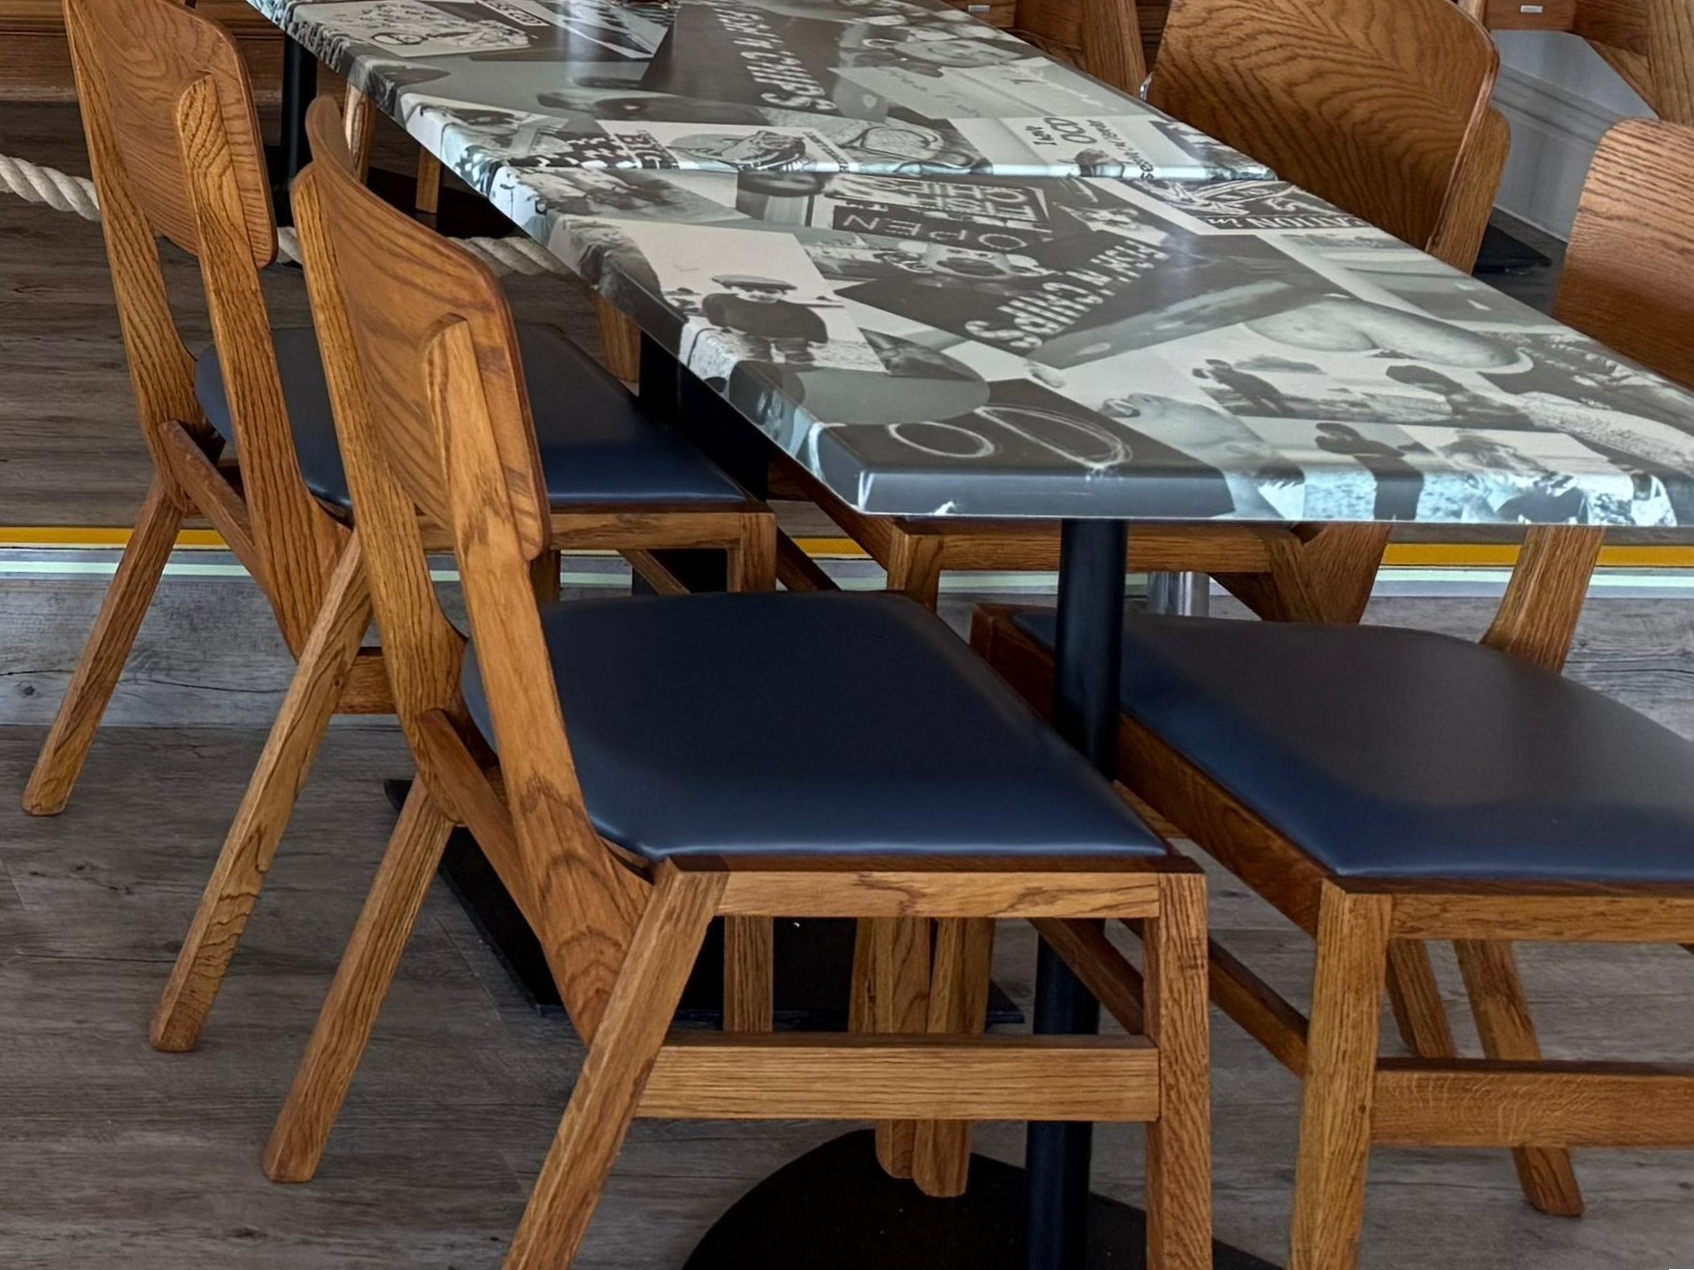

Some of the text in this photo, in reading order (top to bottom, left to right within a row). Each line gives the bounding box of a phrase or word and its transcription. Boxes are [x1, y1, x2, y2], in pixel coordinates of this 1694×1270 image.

[740, 51, 838, 110] CHIPS
[1043, 116, 1098, 145] OCD
[913, 194, 1038, 222] FISH
[842, 213, 1029, 251] OPEN
[964, 281, 1104, 348] CHIPS
